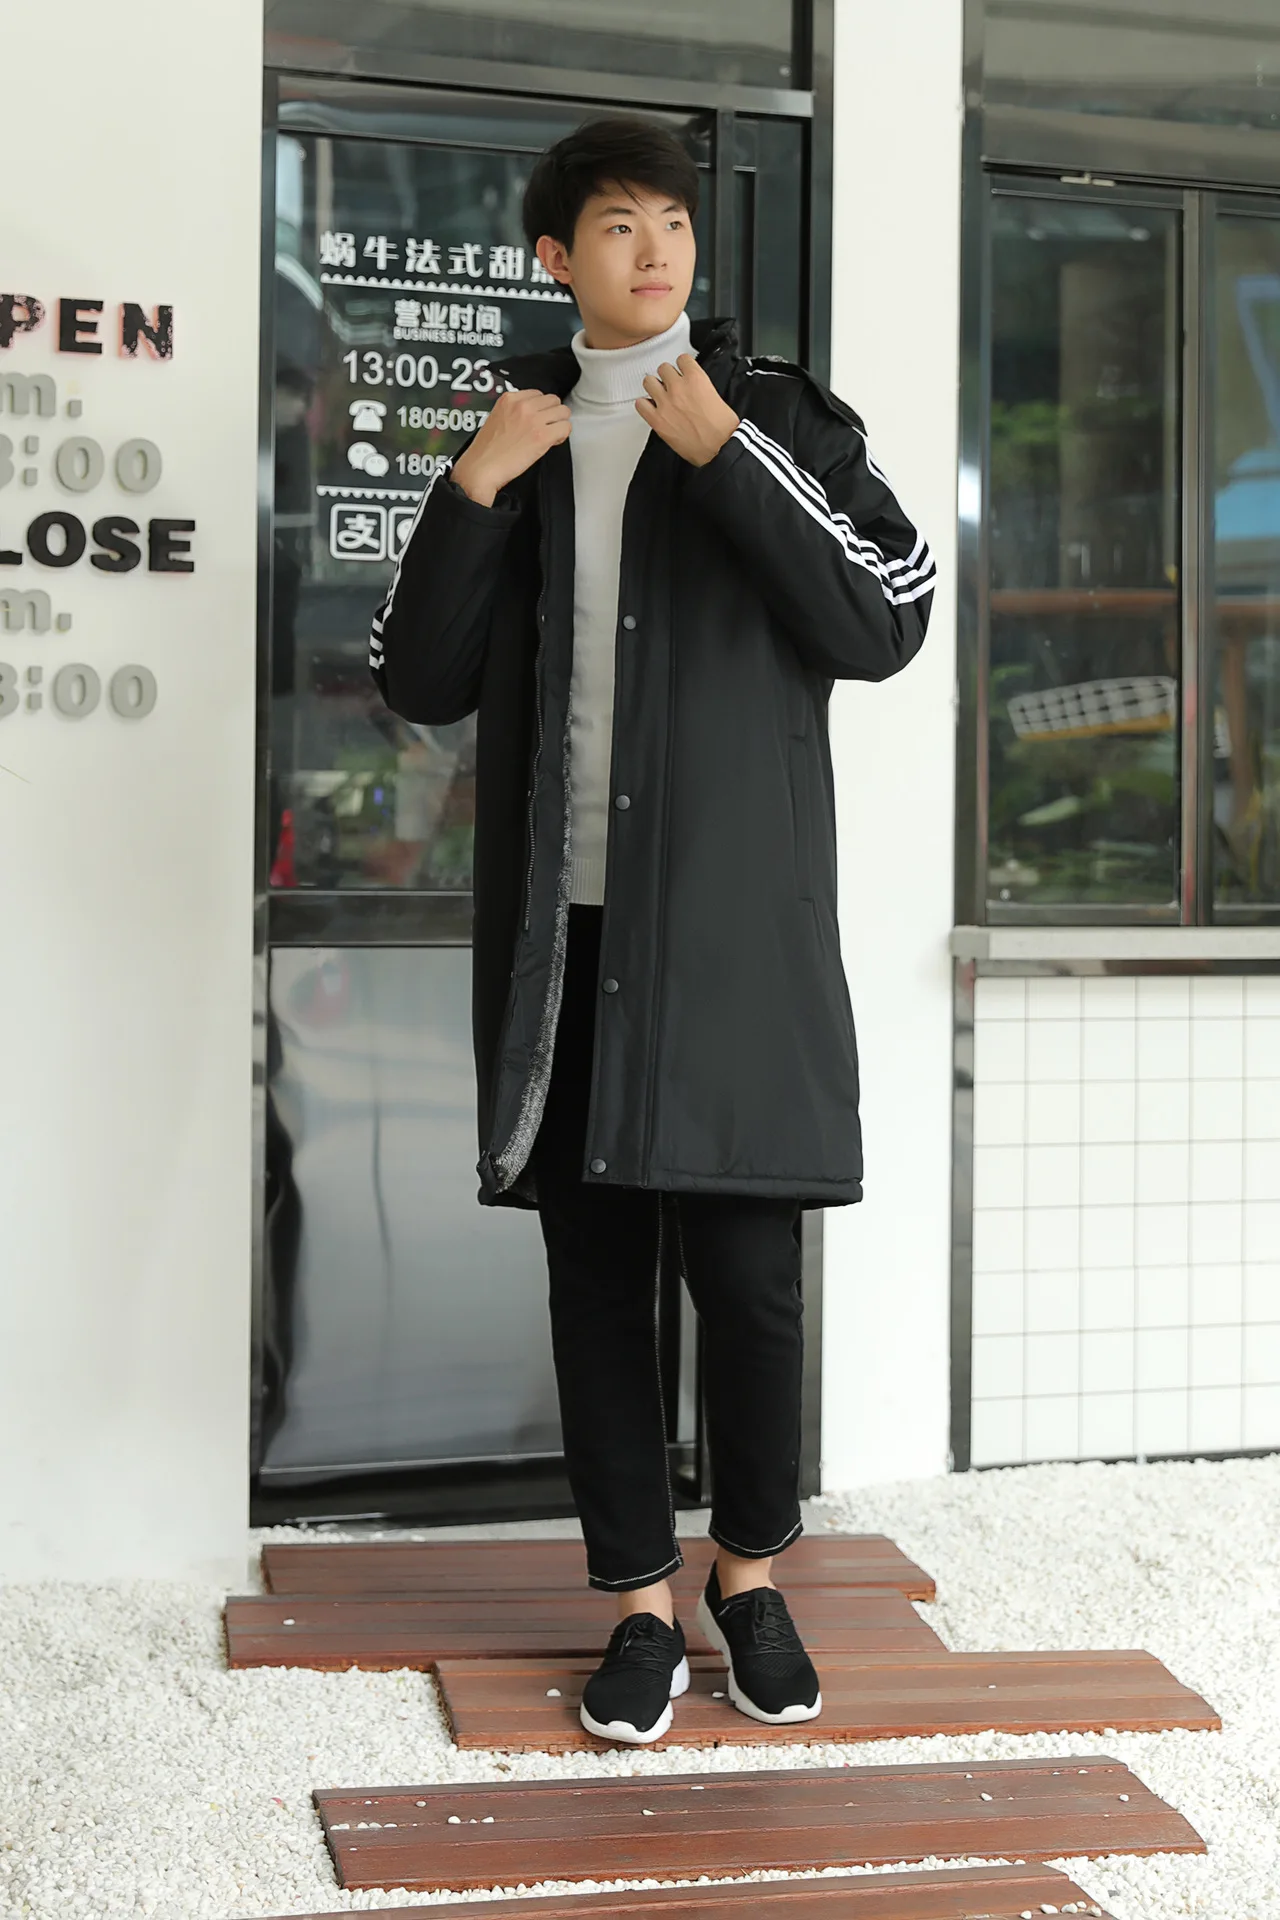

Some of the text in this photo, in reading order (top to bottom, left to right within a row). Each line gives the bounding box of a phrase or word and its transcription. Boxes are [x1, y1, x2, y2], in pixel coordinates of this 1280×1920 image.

[394, 299, 501, 333] 营业时间
[393, 326, 504, 347] BUSINESS HOURS
[396, 405, 490, 432] 1805087
